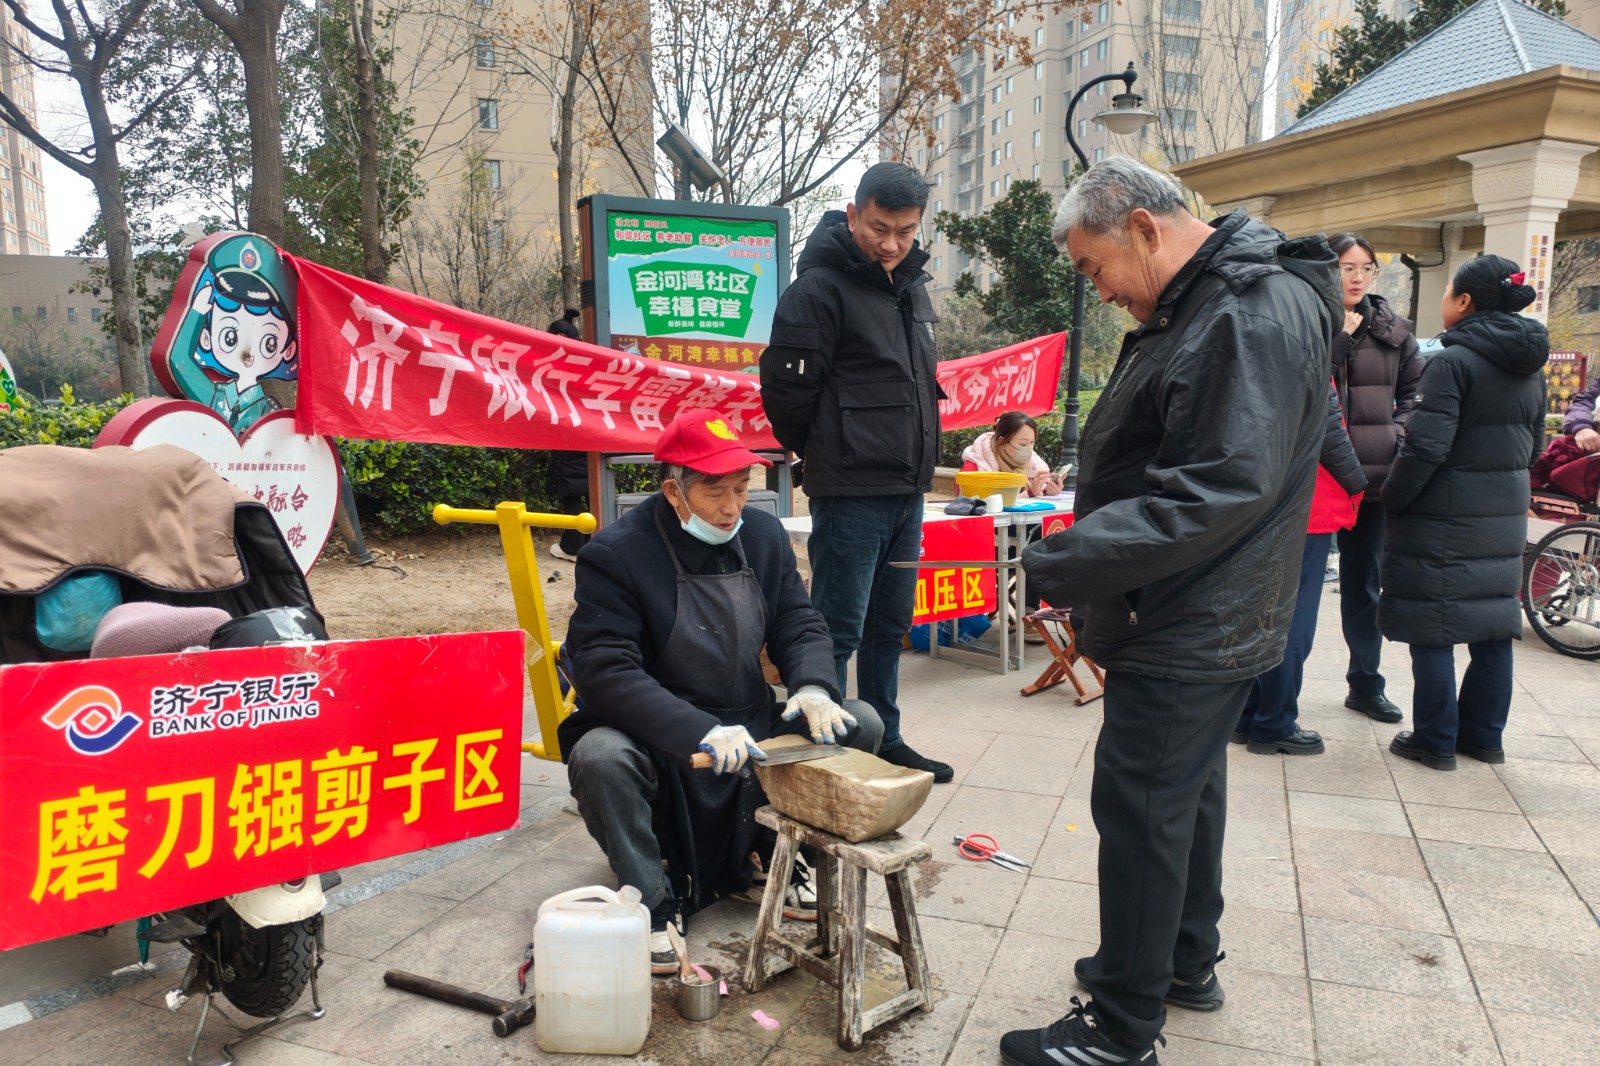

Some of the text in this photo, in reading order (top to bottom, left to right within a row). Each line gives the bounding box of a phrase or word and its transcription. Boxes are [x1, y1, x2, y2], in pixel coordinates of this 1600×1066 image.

[615, 229, 772, 247] 和谐社区 养老助餐 关怀老人 方便居民
[634, 270, 750, 295] 金河湾社区
[648, 296, 741, 319] 幸福食堂
[645, 343, 764, 363] 金河湾幸福食
[153, 674, 318, 715] 济宁银行
[152, 703, 318, 736] BANK OF JINING
[29, 728, 504, 904] 磨刀镪剪子区
